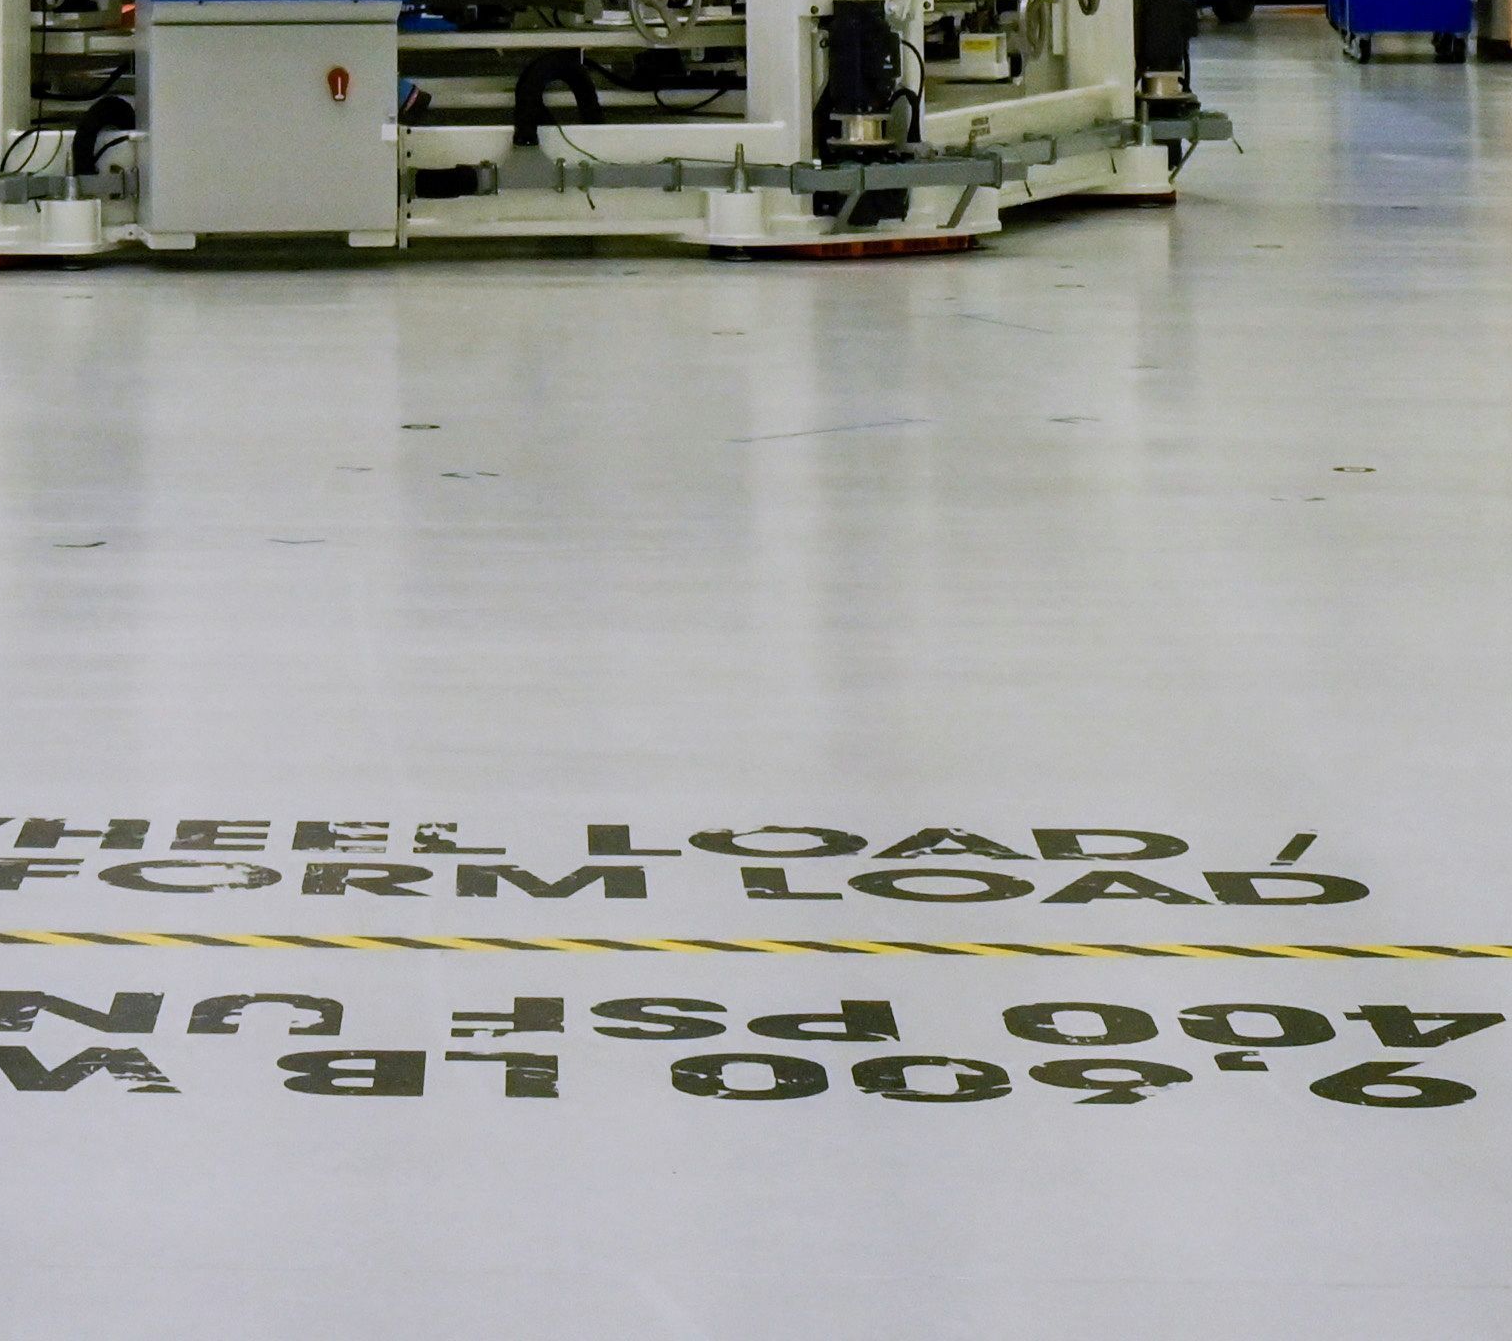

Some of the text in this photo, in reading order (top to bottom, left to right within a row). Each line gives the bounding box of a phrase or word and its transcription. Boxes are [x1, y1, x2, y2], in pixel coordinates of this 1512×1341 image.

[586, 824, 1190, 861] LOAD
[740, 866, 1371, 906] LOAD
[451, 996, 901, 1043] PSF
[1001, 1001, 1507, 1048] 400
[276, 1049, 560, 1099] LB
